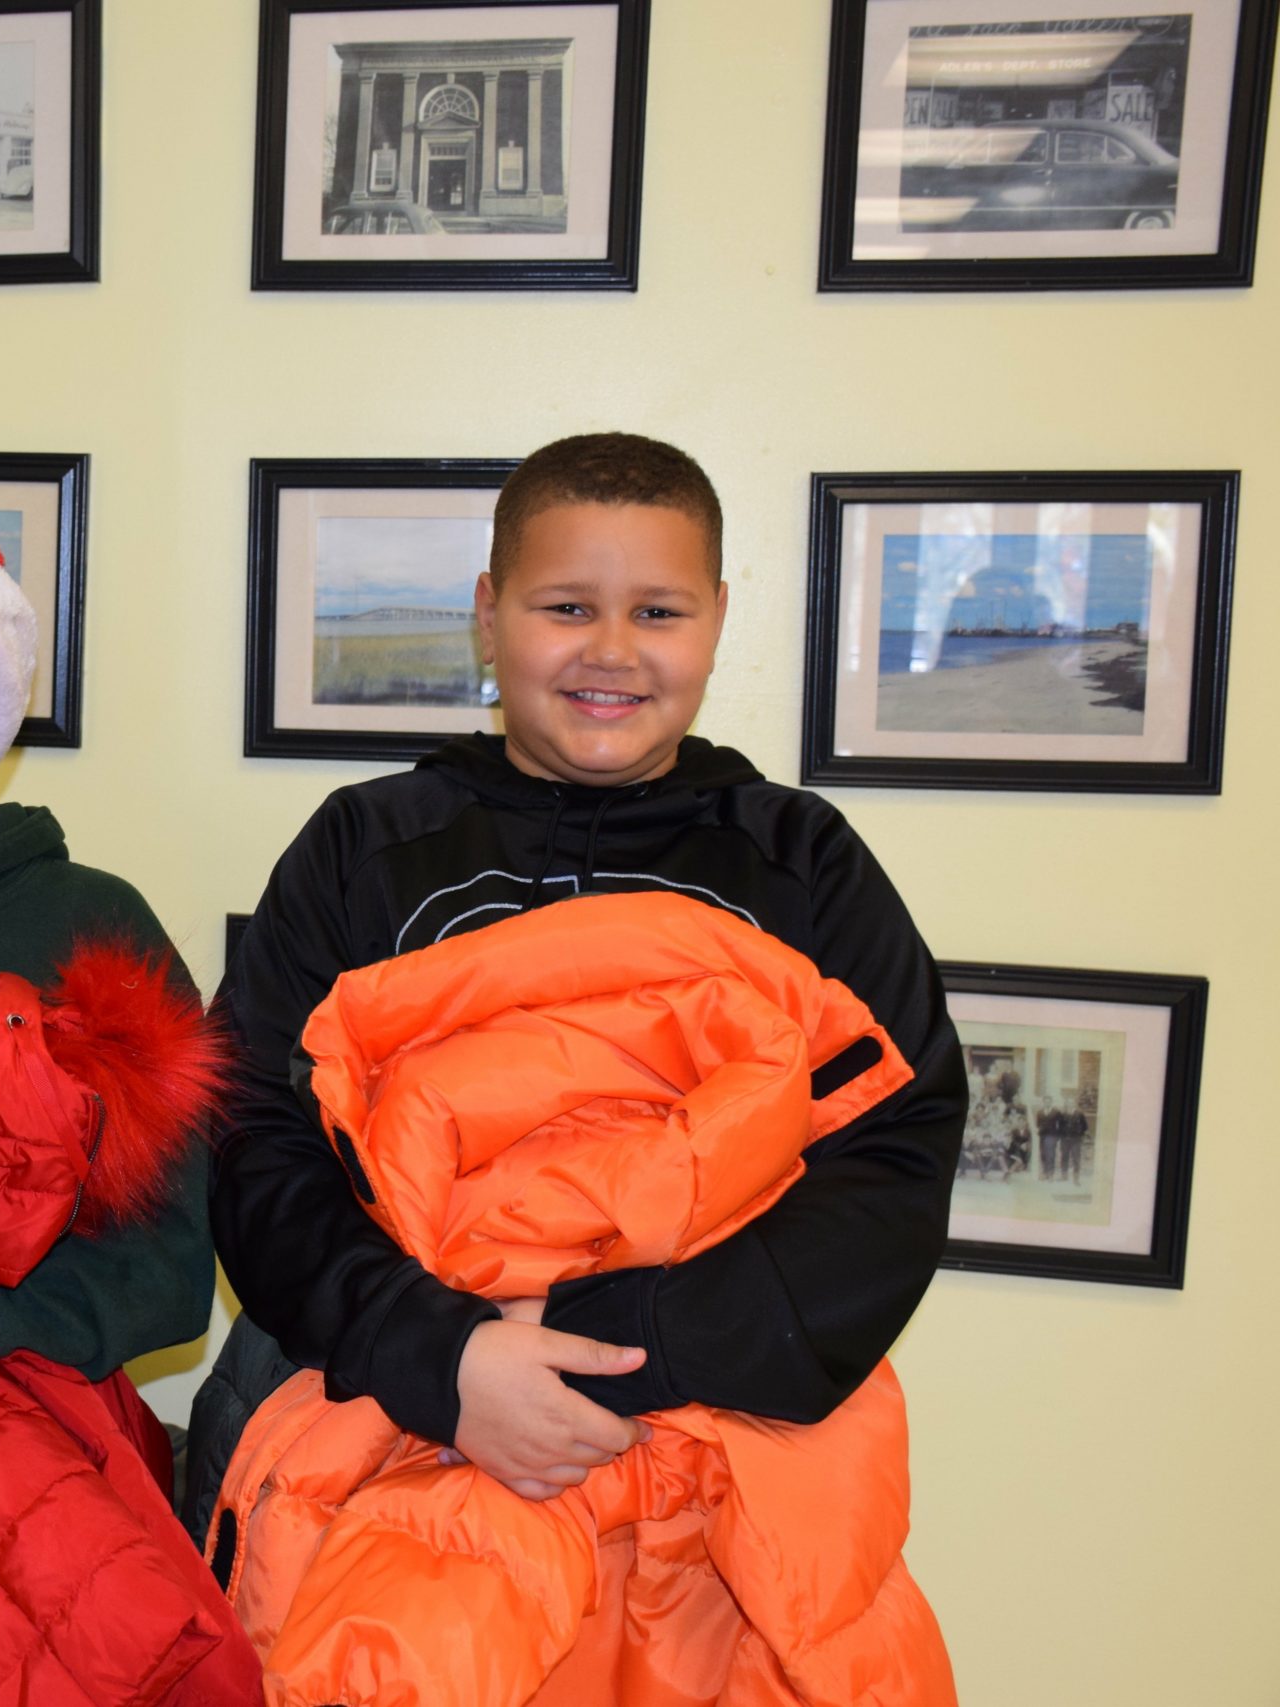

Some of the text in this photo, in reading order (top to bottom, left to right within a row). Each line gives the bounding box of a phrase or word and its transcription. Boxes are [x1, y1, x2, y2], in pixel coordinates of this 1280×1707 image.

[939, 57, 1093, 72] ADLER'S DEPT. STORE
[1109, 92, 1154, 122] SALE
